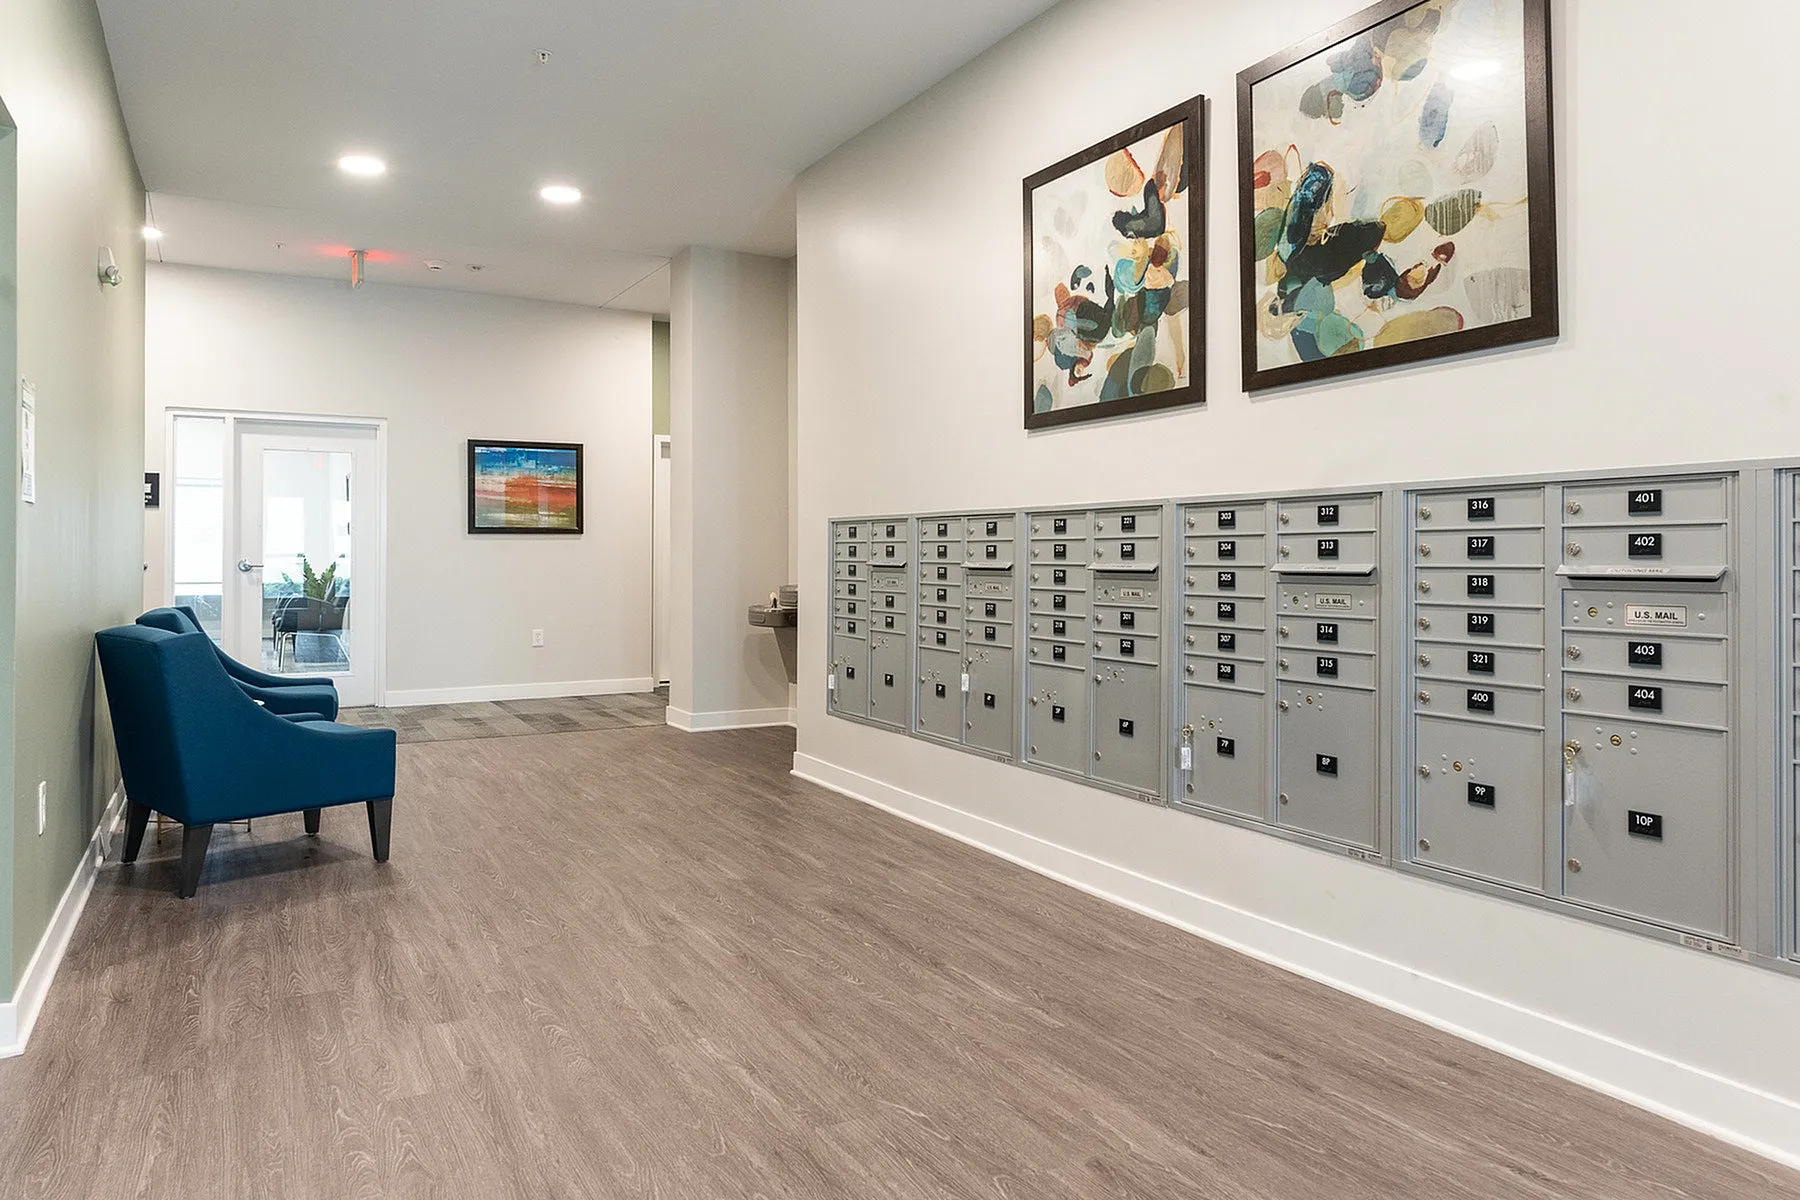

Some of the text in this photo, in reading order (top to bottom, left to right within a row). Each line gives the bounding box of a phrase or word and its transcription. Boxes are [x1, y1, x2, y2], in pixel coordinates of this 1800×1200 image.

[1634, 492, 1654, 503] 401
[1471, 500, 1489, 510] 316
[1220, 512, 1232, 520] 303
[1320, 507, 1334, 516] 312
[1320, 541, 1334, 550] 313
[1471, 538, 1488, 548] 317
[1634, 536, 1655, 546] 402
[1220, 543, 1232, 551] 304
[1220, 573, 1232, 581] 305
[1471, 577, 1489, 587] 318
[1220, 604, 1232, 612] 306
[1471, 615, 1489, 625] 319
[1634, 610, 1678, 620] U.S. MAIL
[1320, 625, 1333, 634] 314
[1220, 634, 1231, 642] 307
[1634, 645, 1655, 656] 403
[1320, 658, 1333, 668] 315
[1472, 653, 1488, 664] 321
[1220, 665, 1231, 673] 308
[1471, 692, 1489, 703] 400
[1634, 689, 1655, 700] 404
[1221, 739, 1229, 747] 7P
[1321, 757, 1331, 765] 8P
[1474, 786, 1486, 796] 9P
[1635, 814, 1654, 826] 10P
